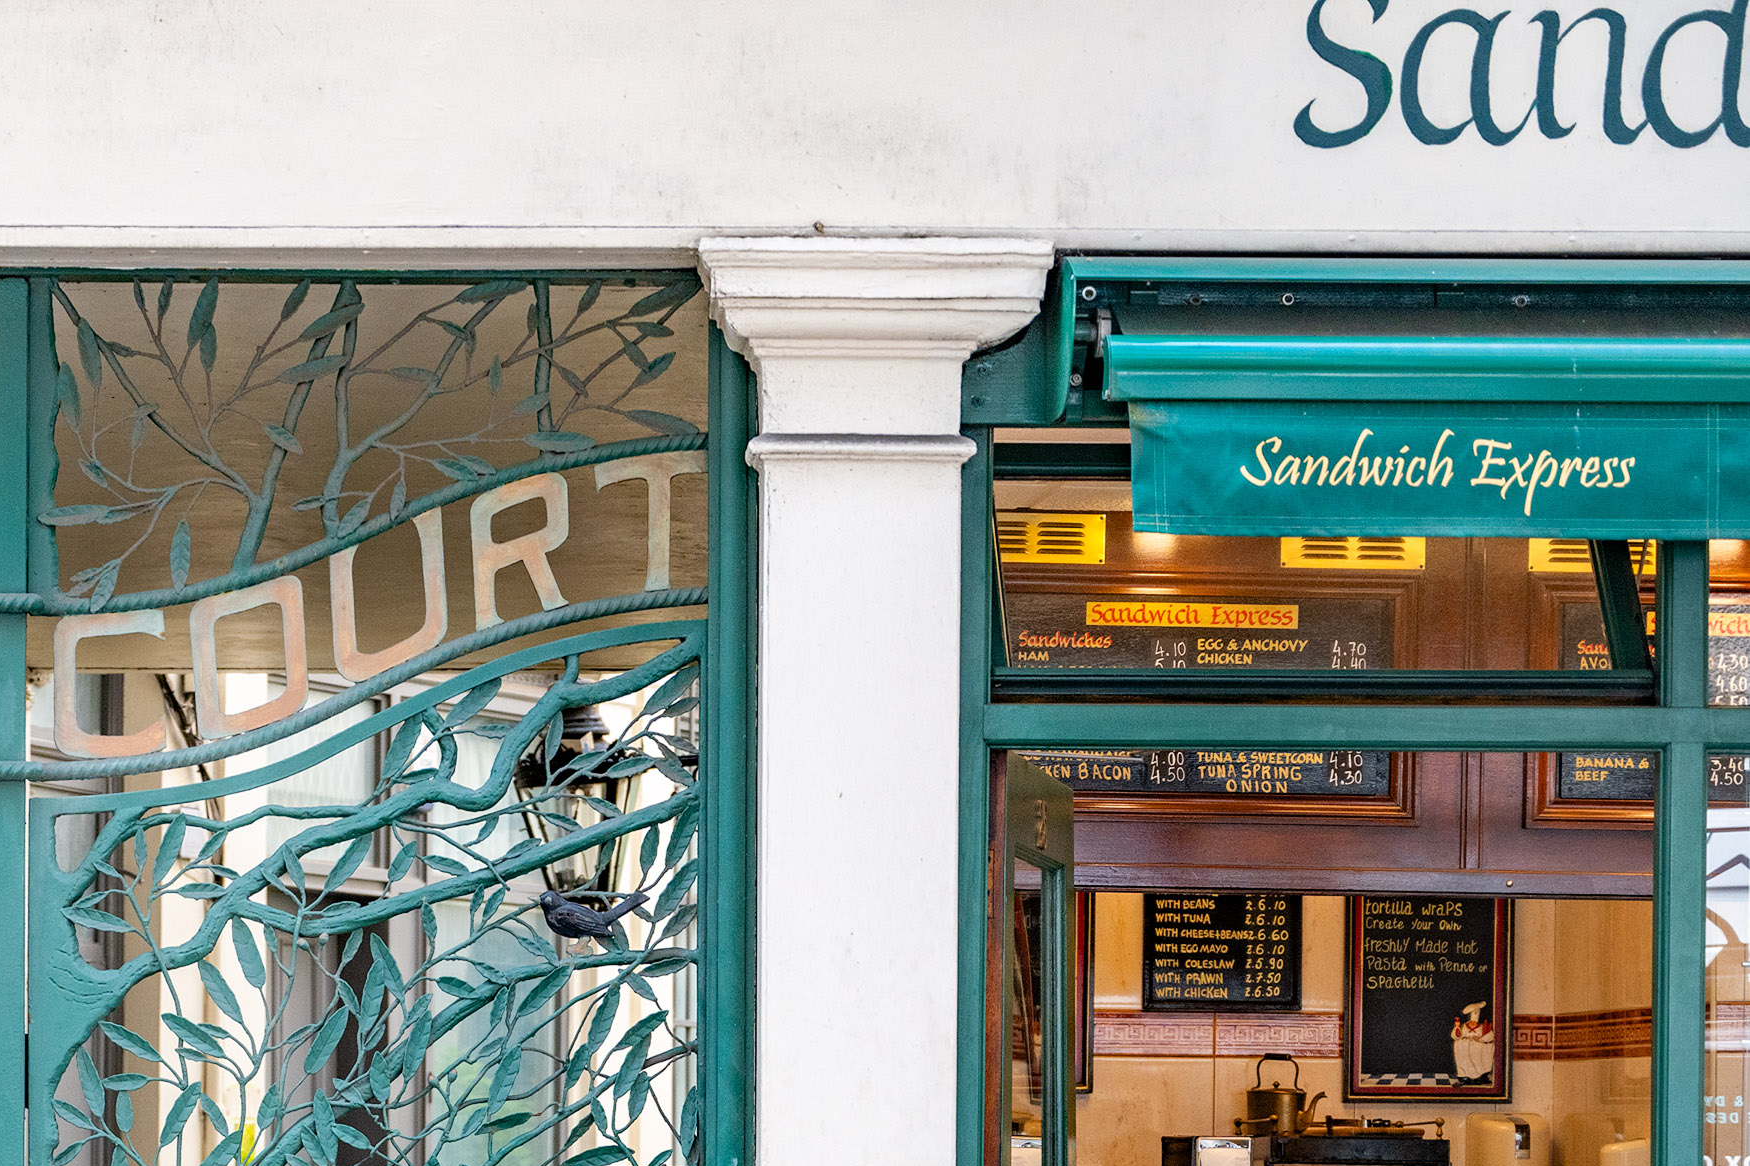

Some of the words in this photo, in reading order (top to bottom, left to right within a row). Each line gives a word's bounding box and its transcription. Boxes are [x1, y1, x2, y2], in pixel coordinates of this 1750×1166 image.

[1239, 428, 1456, 489] Sandwich
[1470, 437, 1637, 517] Express
[53, 450, 707, 760] COURT
[1091, 603, 1201, 625] Sandwich
[1211, 606, 1294, 628] Express
[1018, 630, 1113, 649] Sandwiches
[1197, 638, 1225, 651] EGG
[1226, 639, 1239, 651] &
[1241, 639, 1309, 652] ANCHOVY
[1155, 640, 1186, 657] 4.10
[1332, 640, 1367, 657] 4.70
[1018, 651, 1050, 662] HAM
[1197, 653, 1253, 665] CHICKEN
[1716, 676, 1748, 692] 4.60
[1150, 751, 1185, 767] 4.00
[1197, 752, 1233, 763] TUNA
[1236, 752, 1248, 763] &
[1250, 752, 1323, 764] SWEETCORN
[1575, 757, 1634, 769] BANANA
[1078, 762, 1131, 780] BACON
[1150, 766, 1186, 784] 4.50
[1198, 764, 1237, 779] TUNA
[1241, 763, 1302, 781] SPRING
[1329, 769, 1363, 786] 4.30
[1575, 770, 1609, 782] BEEF
[1225, 779, 1288, 793] ONION
[1710, 773, 1744, 786] 4.50
[1156, 899, 1181, 910] WITH
[1182, 898, 1216, 910] BEANS
[1155, 912, 1181, 923] WITH
[1182, 913, 1211, 924] TUNA
[1365, 916, 1405, 930] Create
[1154, 927, 1178, 938] WITH
[1154, 943, 1178, 953] WITH
[1180, 944, 1199, 954] EGG
[1199, 944, 1229, 954] MAYO
[1415, 937, 1449, 954] Made
[1456, 941, 1479, 955] Hot
[1154, 958, 1179, 968] WITH
[1184, 959, 1235, 969] COLESLAW
[1415, 961, 1436, 972] with
[1439, 957, 1475, 972] Penne
[1154, 972, 1180, 984] WITH
[1186, 972, 1224, 985] PRAWN
[1155, 987, 1181, 998] WITH
[1184, 986, 1229, 999] CHICKEN
